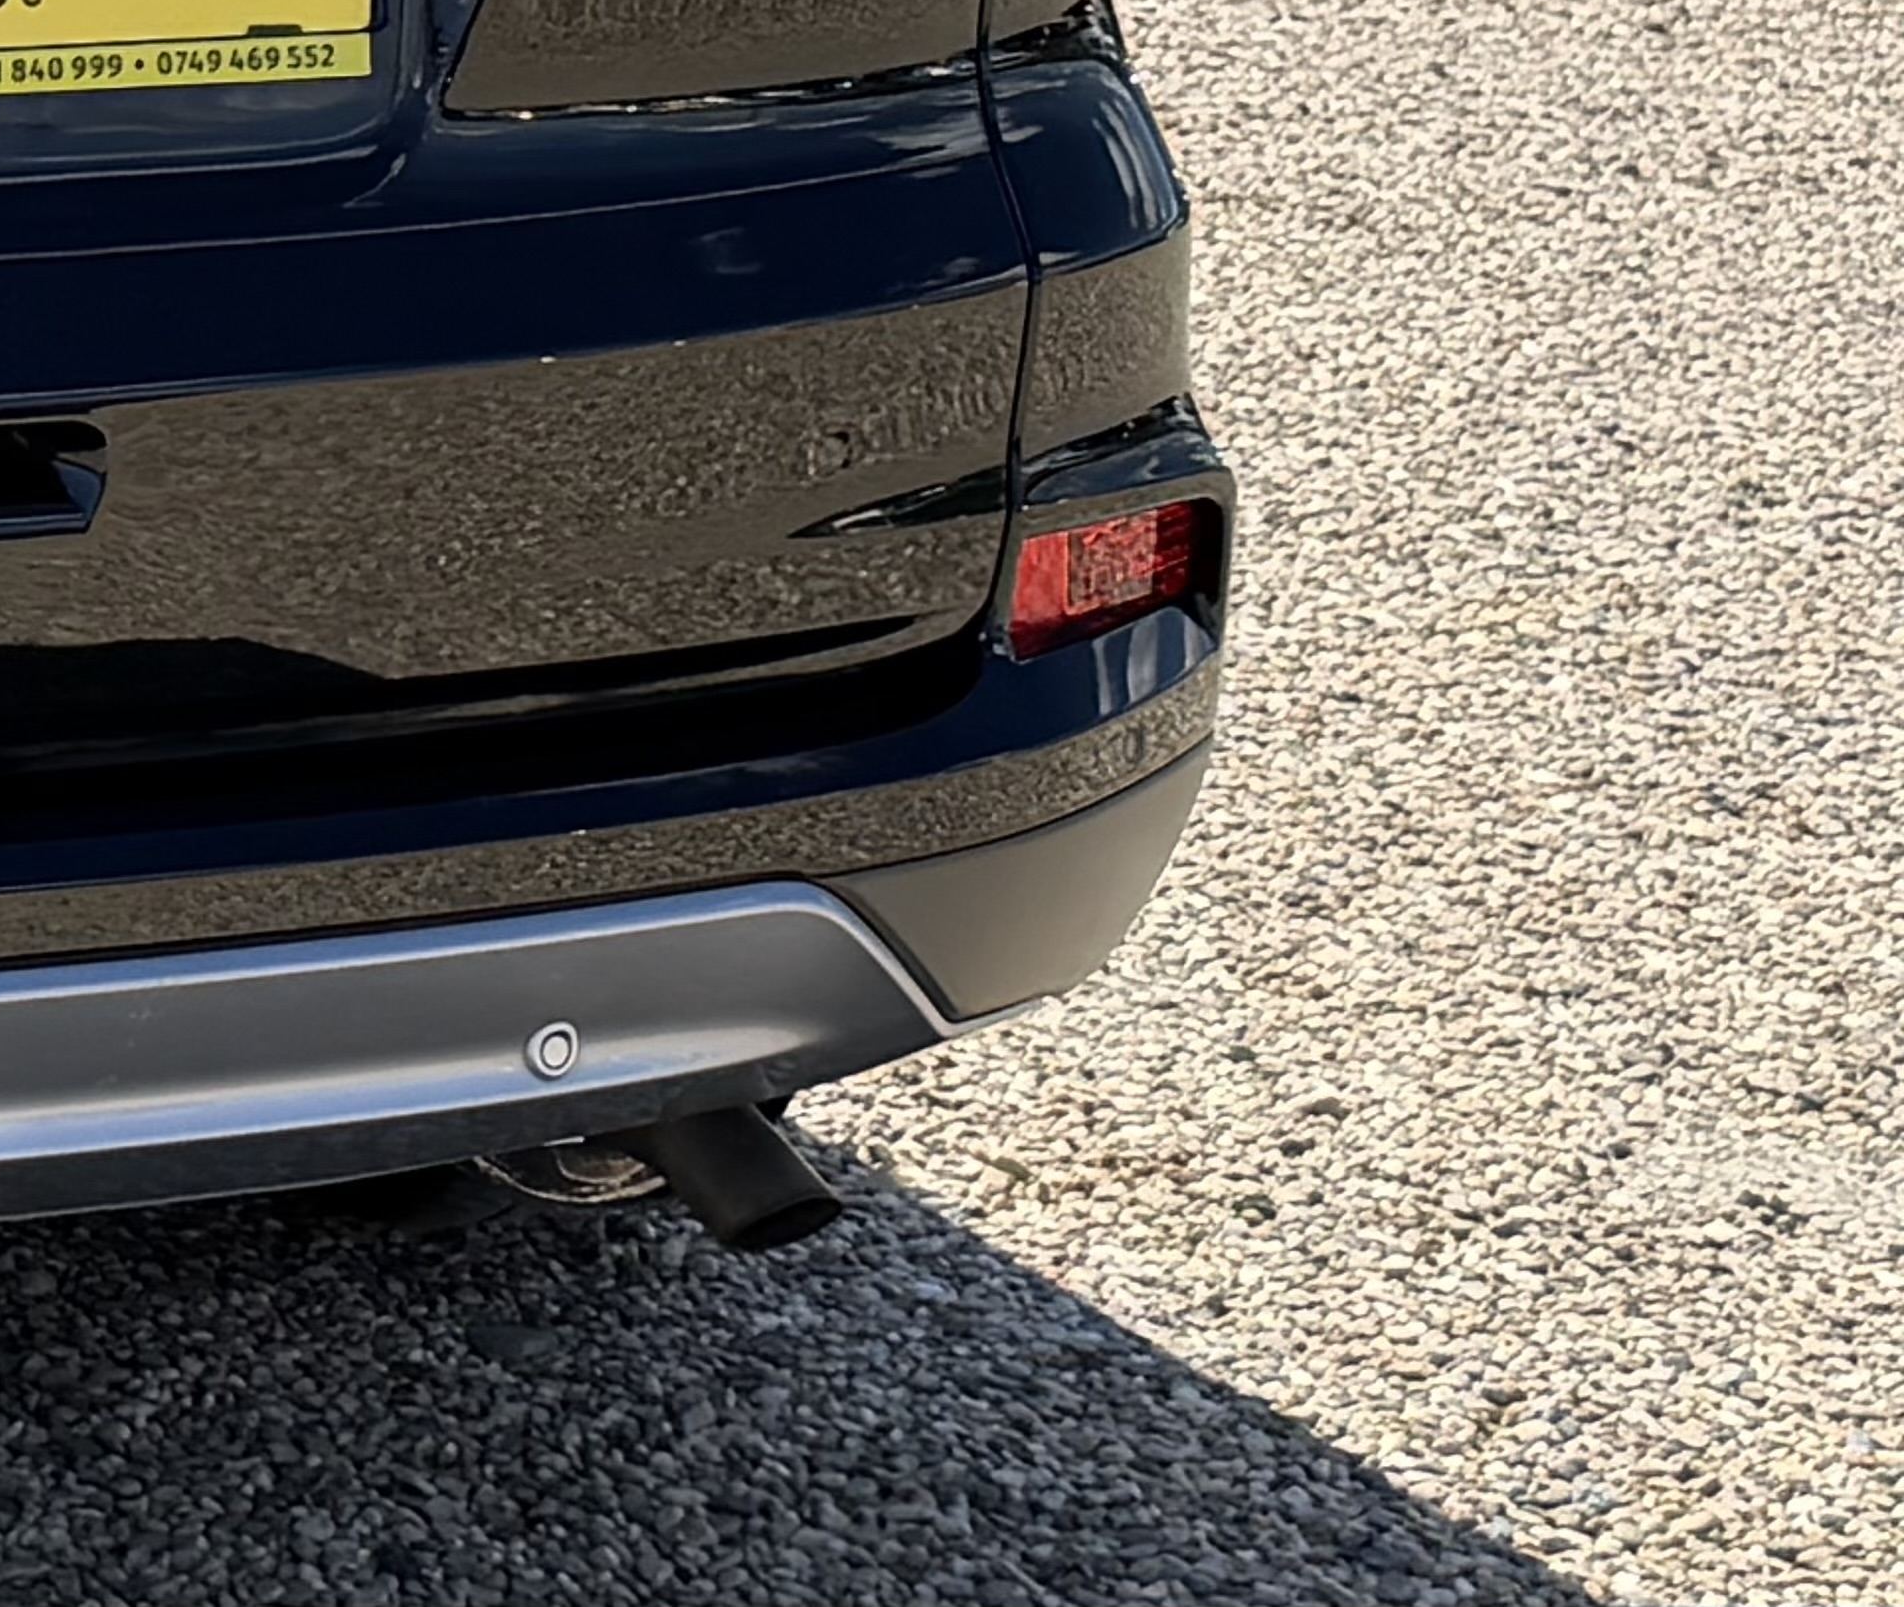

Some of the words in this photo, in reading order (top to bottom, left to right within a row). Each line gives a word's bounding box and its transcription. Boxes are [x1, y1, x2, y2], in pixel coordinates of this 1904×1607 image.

[10, 56, 64, 83] 840
[71, 53, 124, 80] 999
[156, 49, 222, 75] 0749
[228, 45, 281, 72] 469
[286, 43, 336, 69] 552
